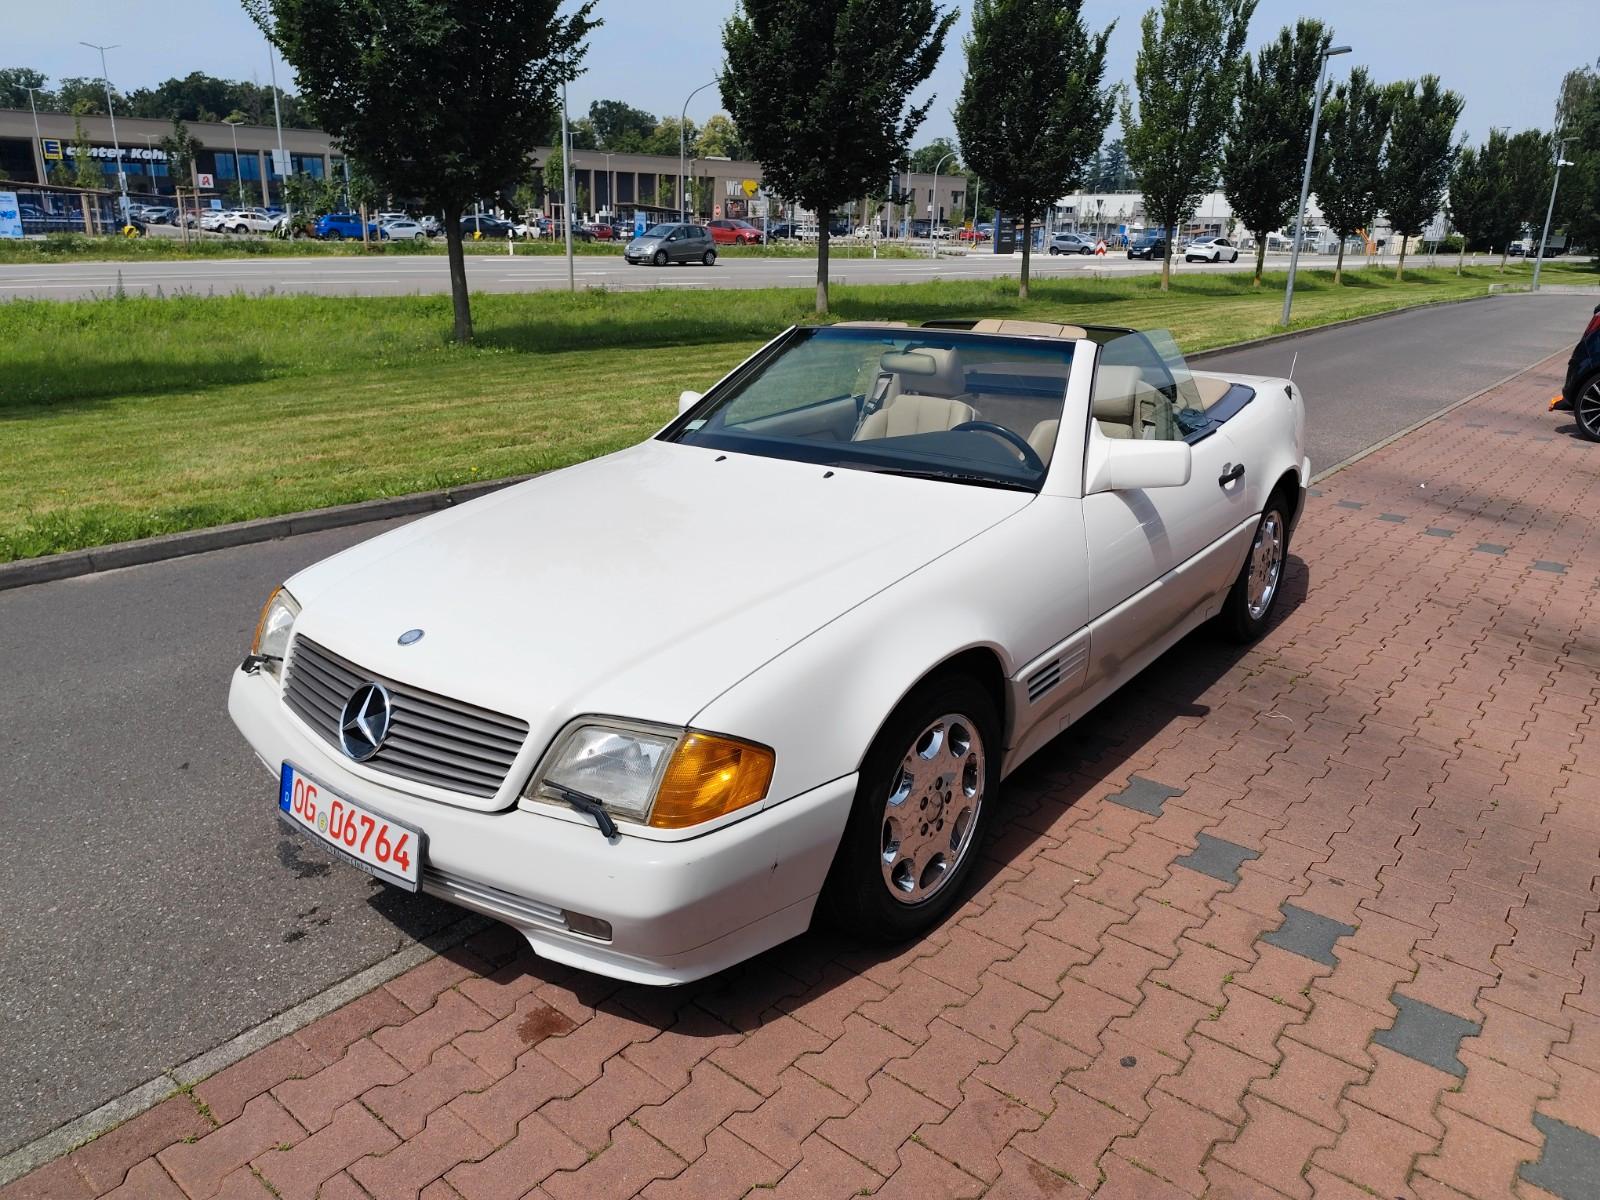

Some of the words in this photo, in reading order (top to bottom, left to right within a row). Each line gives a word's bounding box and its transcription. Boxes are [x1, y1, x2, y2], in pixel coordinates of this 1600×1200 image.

[726, 180, 743, 196] Wir
[285, 791, 290, 802] D
[294, 778, 318, 824] OG
[329, 800, 410, 872] 06764
